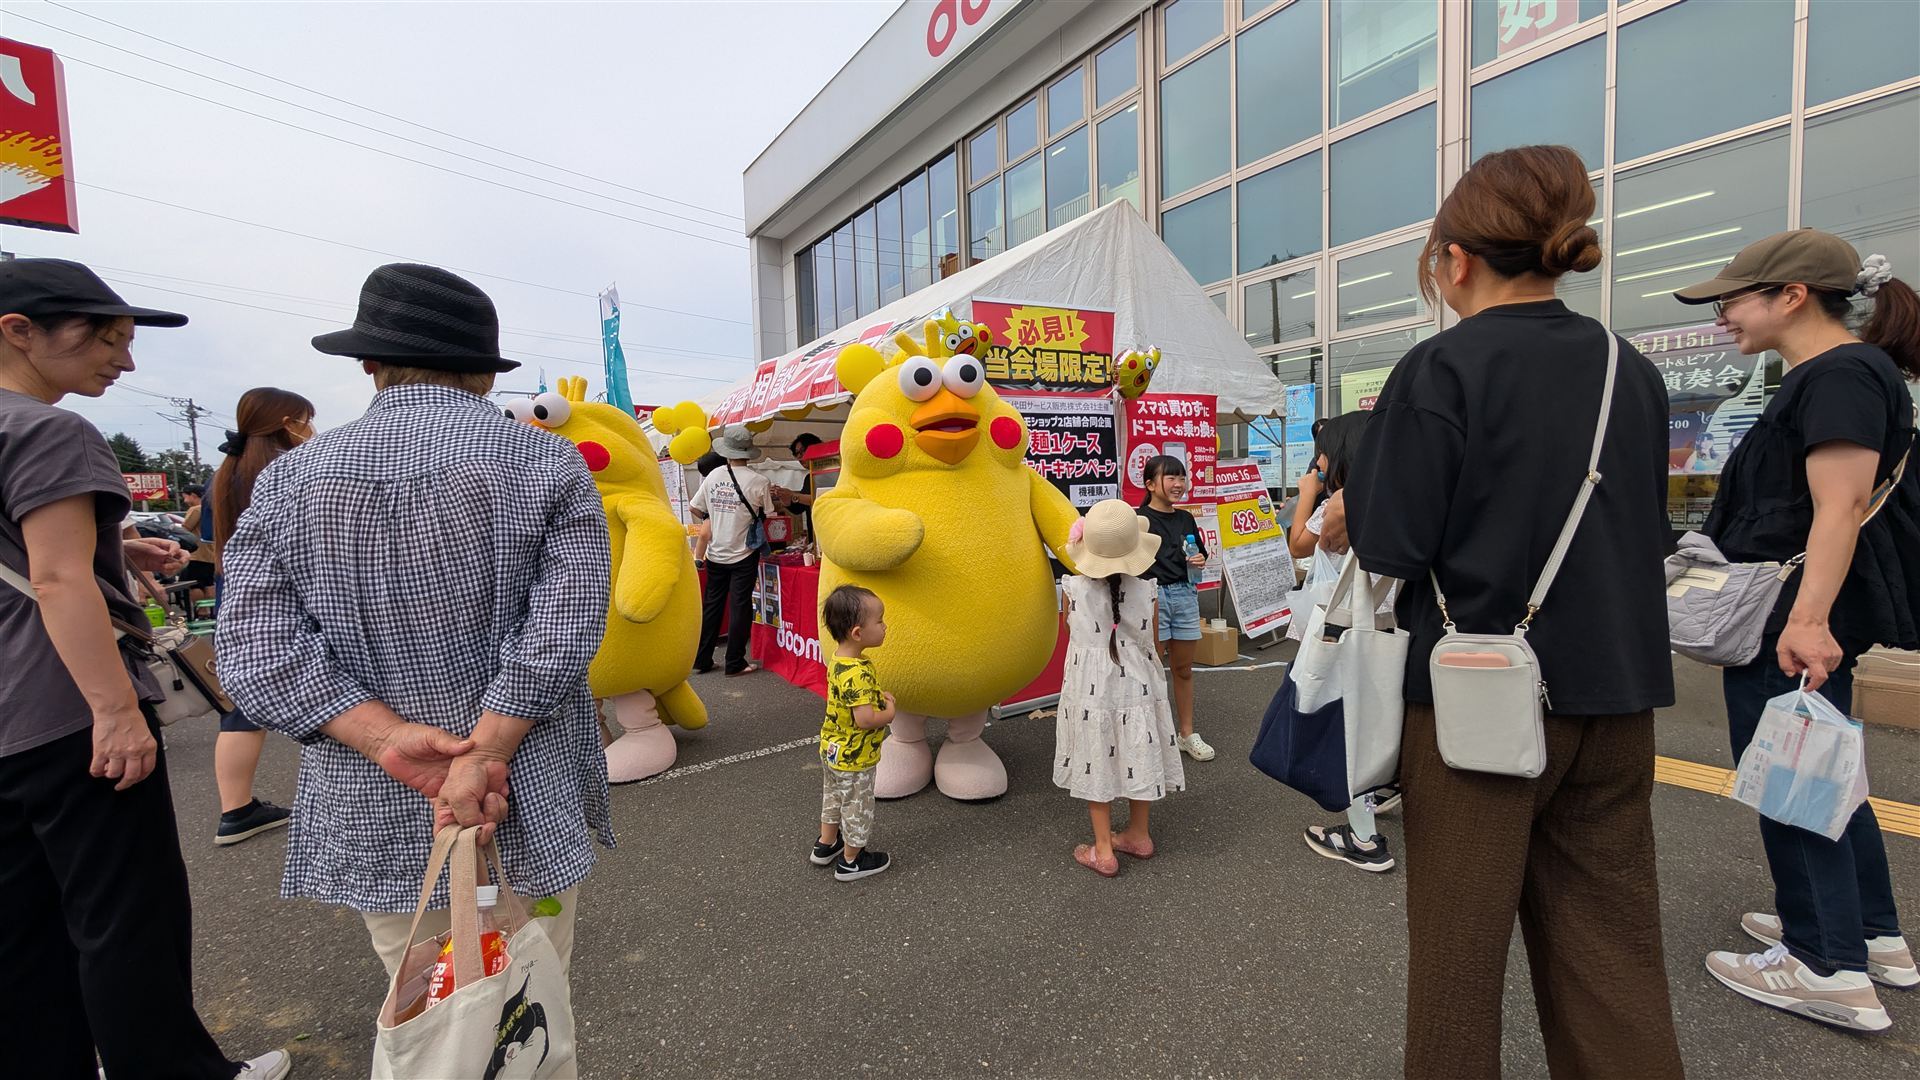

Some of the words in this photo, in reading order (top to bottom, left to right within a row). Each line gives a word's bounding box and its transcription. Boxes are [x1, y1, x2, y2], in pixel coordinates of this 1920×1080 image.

[1017, 315, 1075, 346] 必見!
[984, 348, 1112, 384] 当会場限定!
[714, 343, 866, 416] 料金相談フェ
[1007, 400, 1109, 412] 代田サービス販売株式会社主催
[1136, 399, 1210, 417] スマホ買わずに
[1132, 419, 1215, 438] ドコモへお乗り換え
[1027, 430, 1102, 455] 麺1ケース
[1025, 458, 1117, 478] ントキャンペーン
[1239, 468, 1251, 480] 16
[784, 620, 795, 630] NTT
